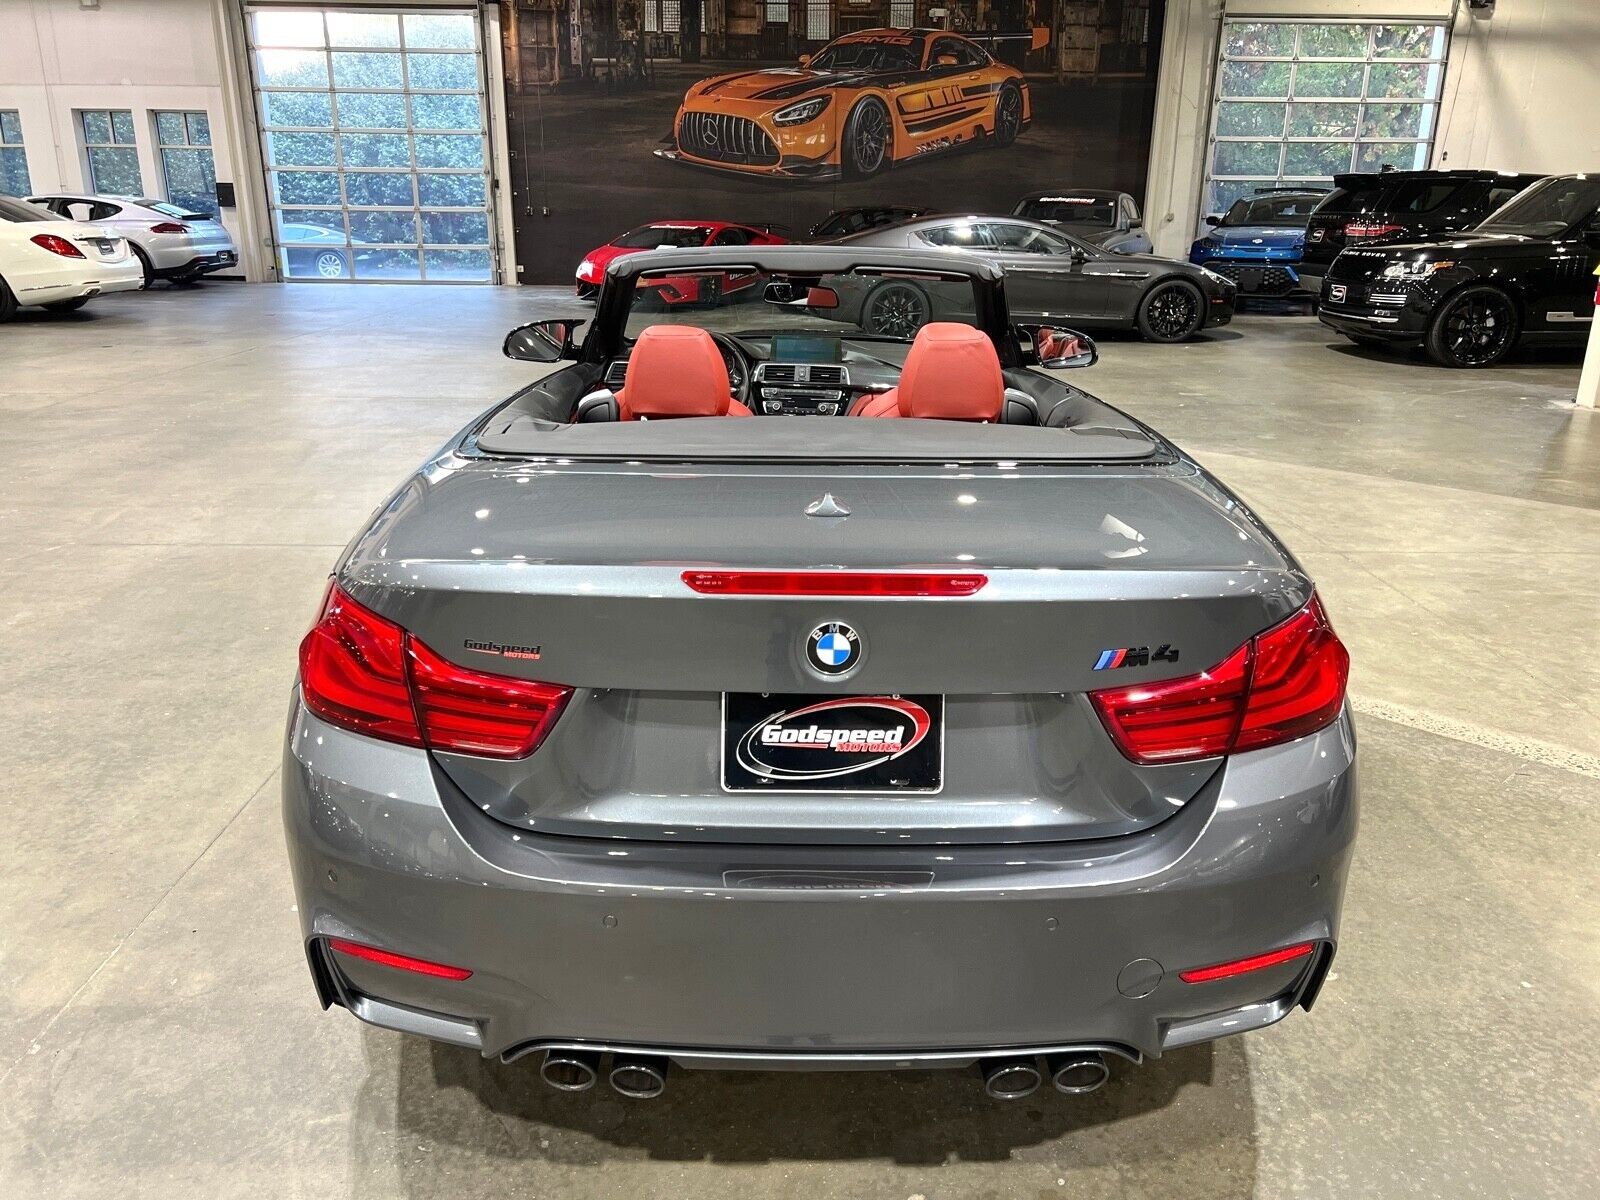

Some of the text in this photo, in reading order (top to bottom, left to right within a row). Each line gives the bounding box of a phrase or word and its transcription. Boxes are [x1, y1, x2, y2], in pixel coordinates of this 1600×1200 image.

[853, 36, 914, 45] AMG
[811, 623, 858, 642] BMW
[464, 638, 541, 654] Godspeed
[503, 651, 540, 660] MOTORS
[1118, 644, 1180, 667] M4
[761, 724, 905, 747] Godspeed
[835, 742, 902, 753] MOTORS
